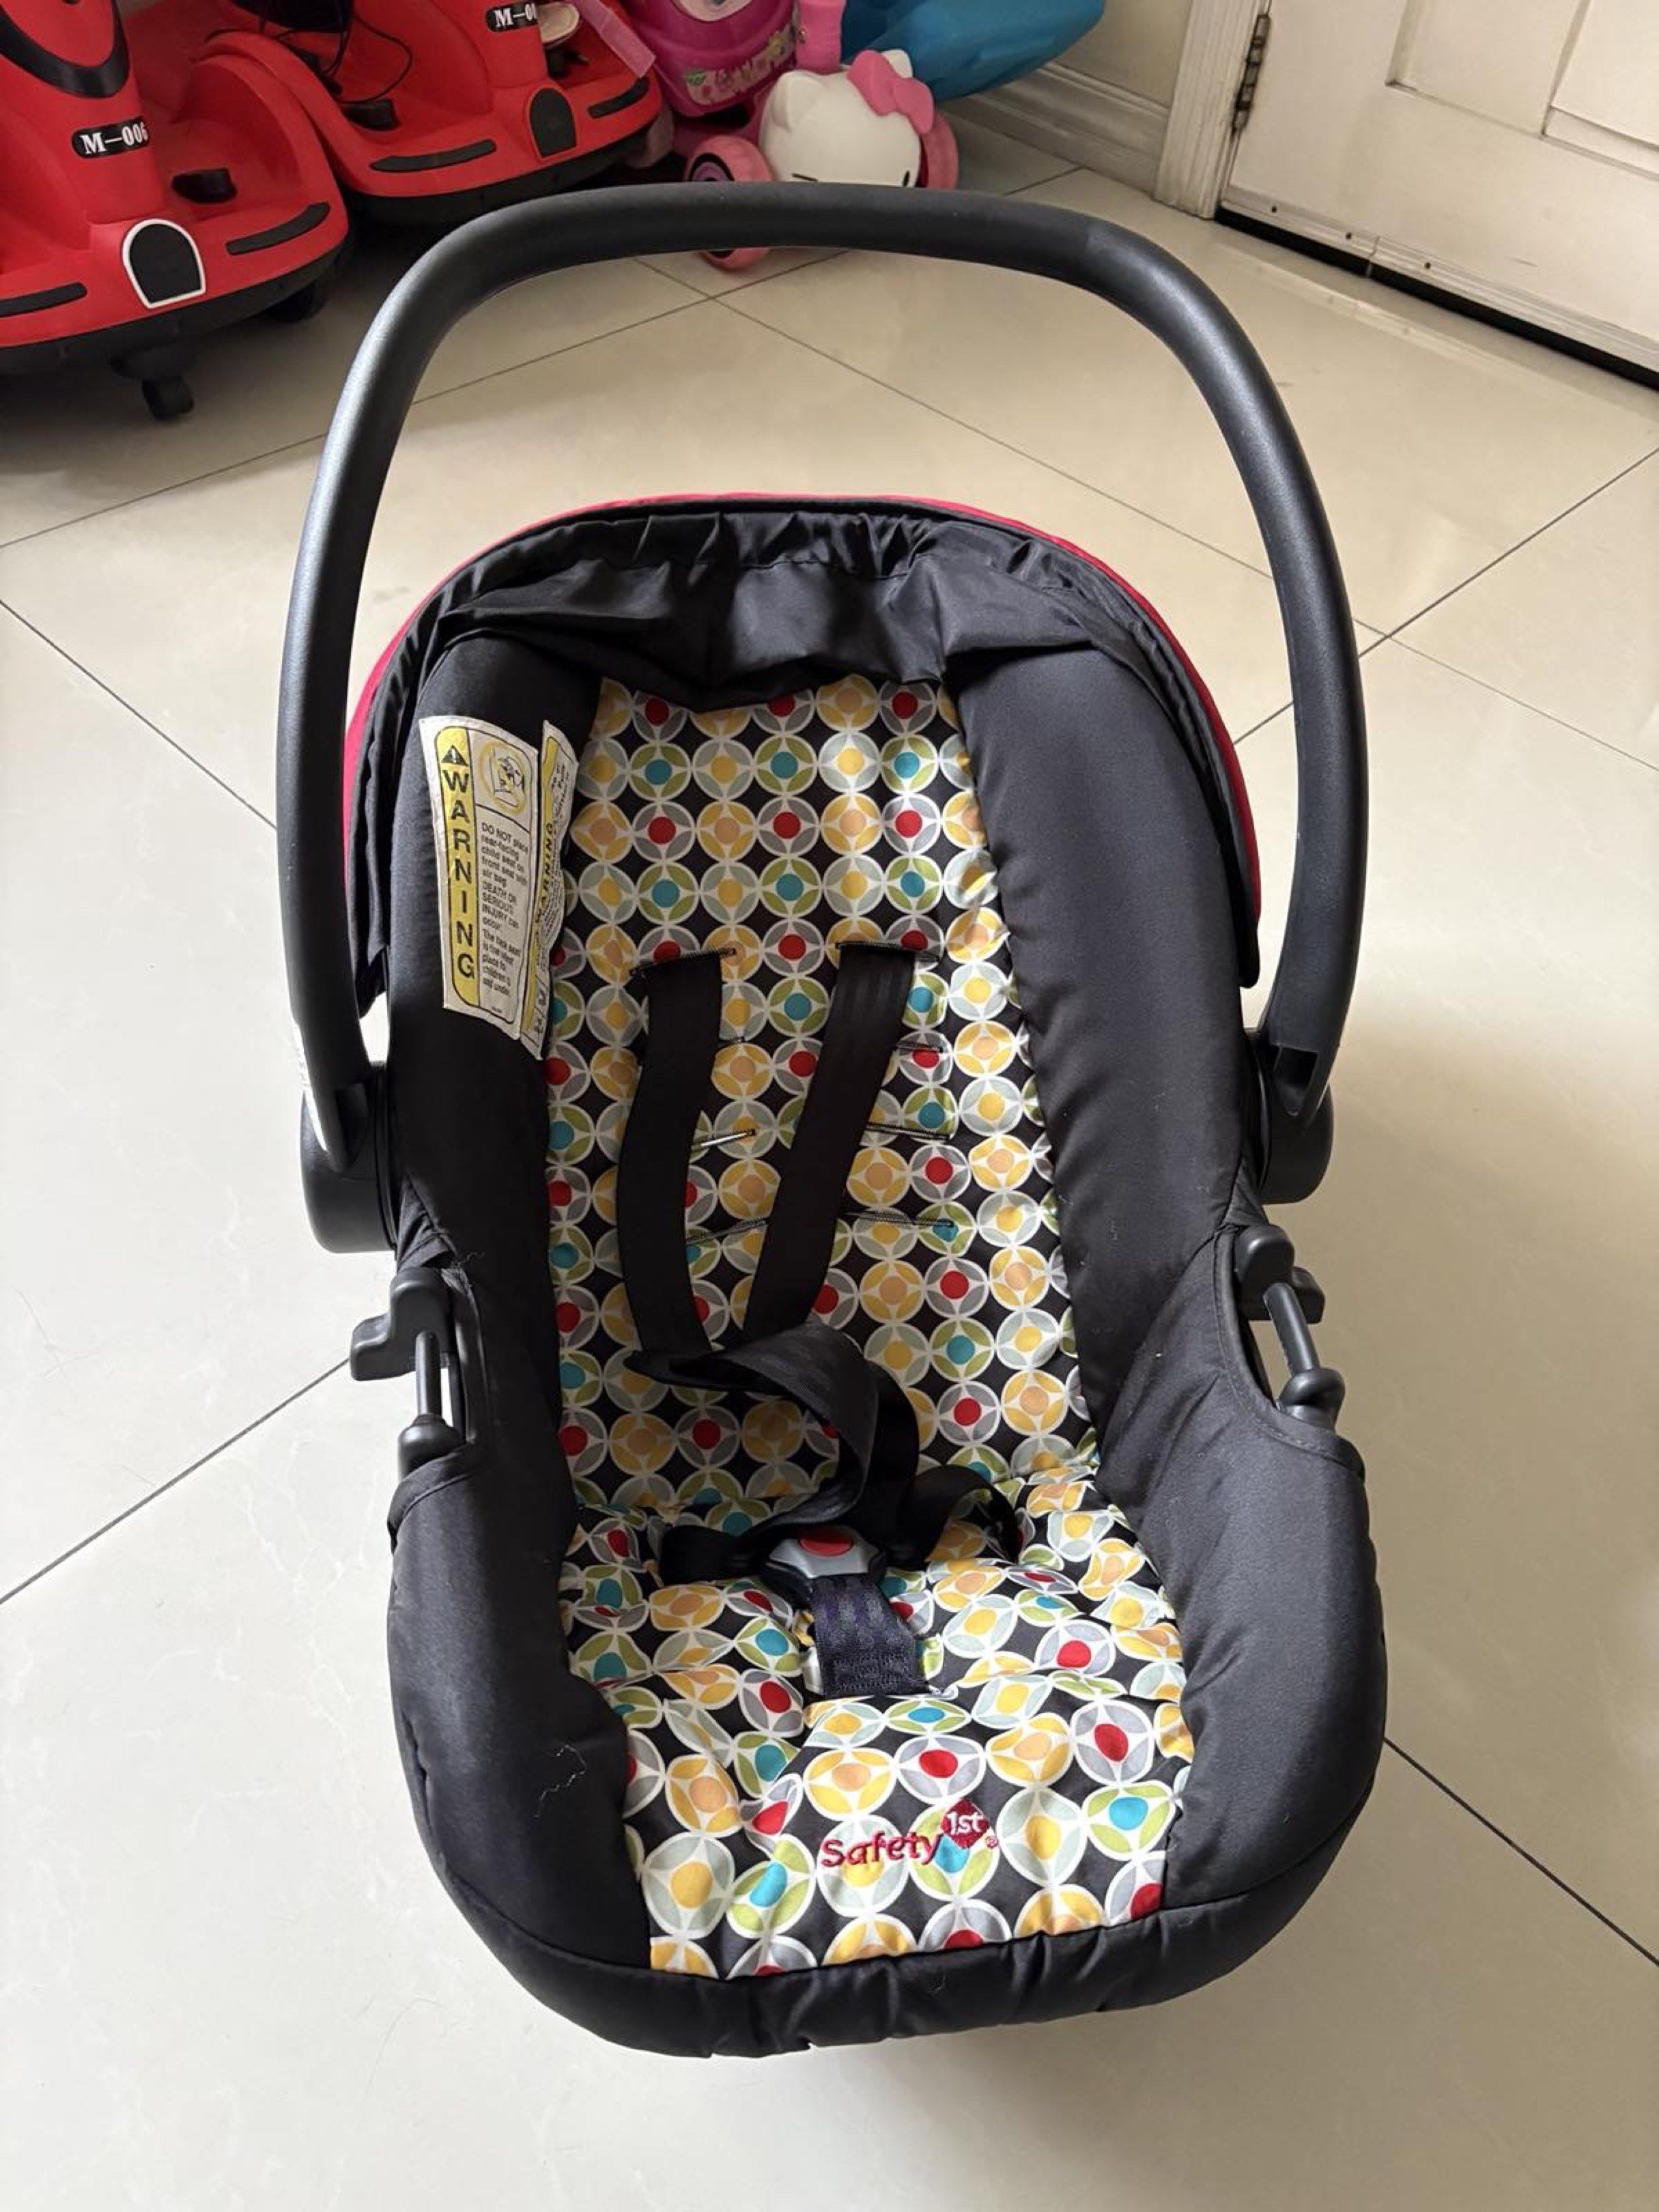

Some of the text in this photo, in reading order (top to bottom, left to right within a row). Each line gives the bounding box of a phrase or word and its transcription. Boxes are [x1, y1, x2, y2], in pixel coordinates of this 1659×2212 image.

[80, 122, 148, 154] M-006
[481, 822, 495, 835] DO
[496, 828, 512, 842] NOT
[441, 769, 475, 980] WARNING
[821, 1830, 943, 1867] Safety
